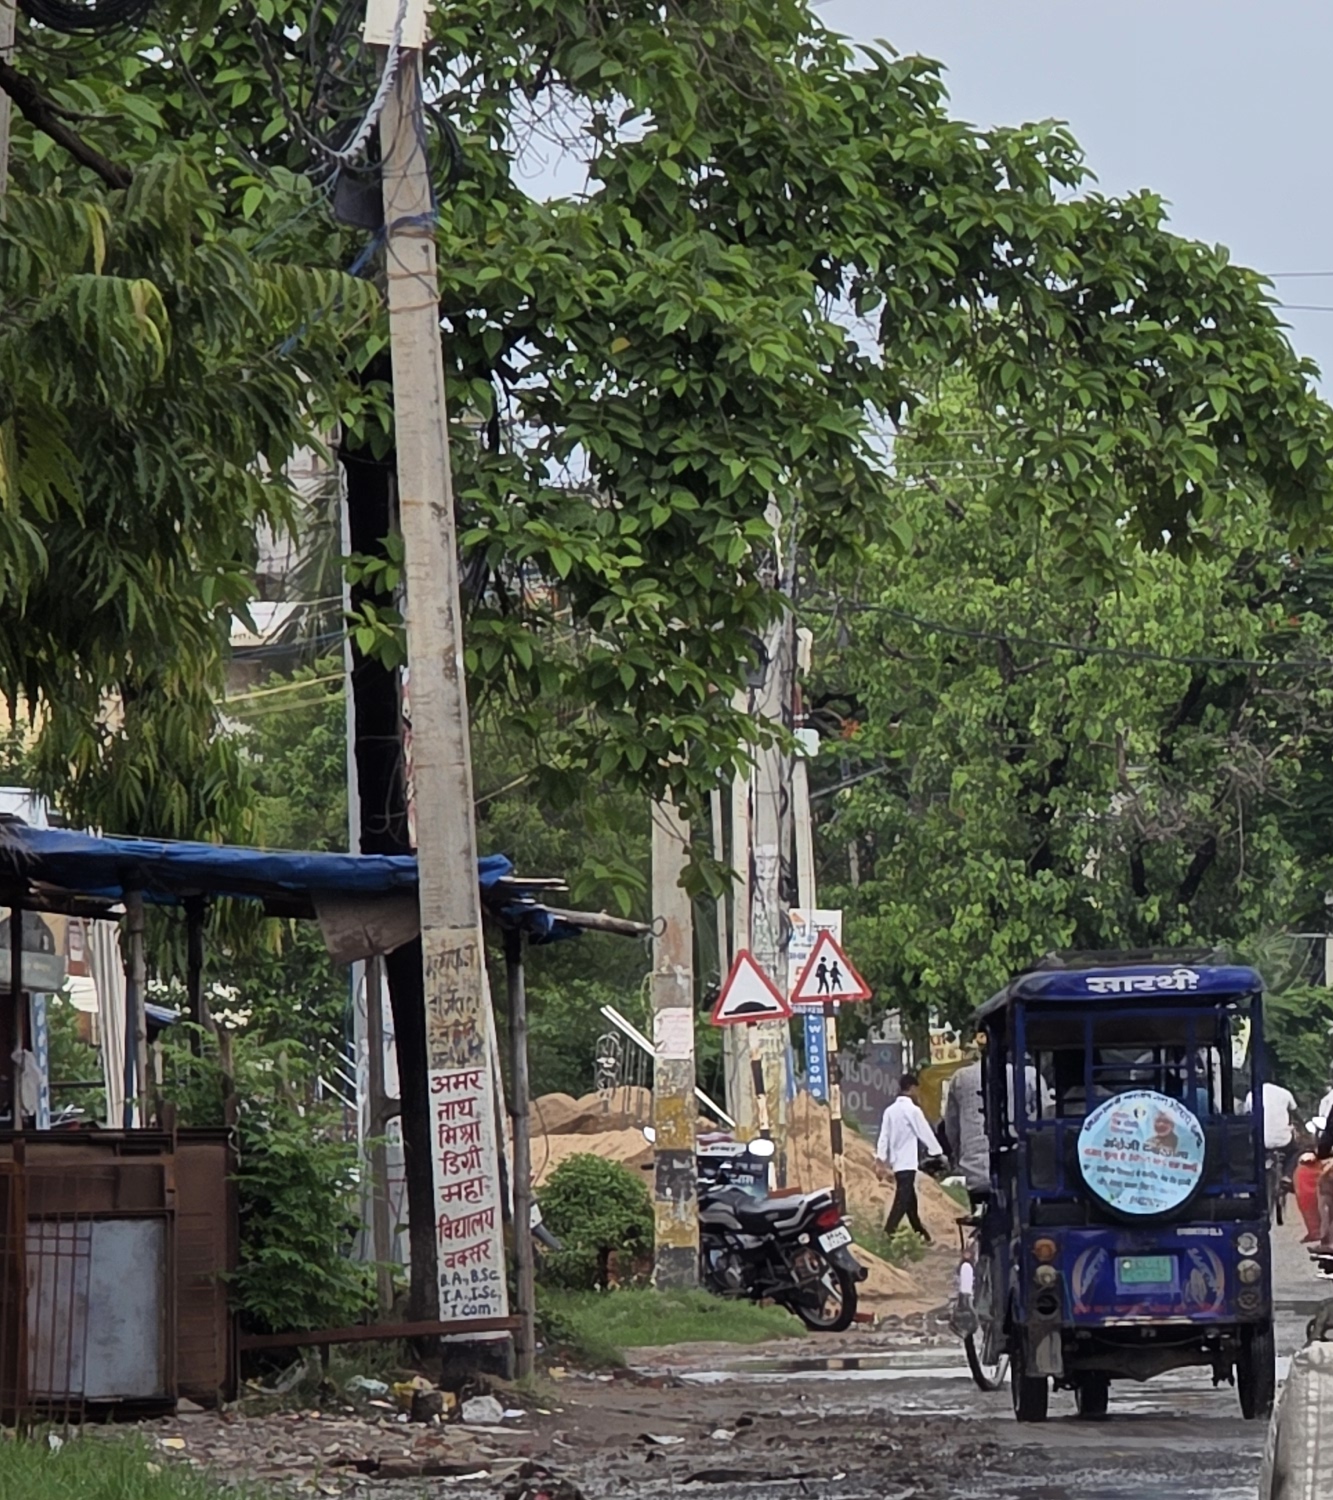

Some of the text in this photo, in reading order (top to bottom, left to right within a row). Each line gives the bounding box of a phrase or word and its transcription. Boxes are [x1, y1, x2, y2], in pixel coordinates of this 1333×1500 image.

[808, 1025, 822, 1083] WISDOM
[431, 1070, 485, 1094] अमर
[437, 1097, 478, 1121] नाथ
[438, 1121, 481, 1149] मिश्रा
[438, 1145, 484, 1176] डिग्री
[438, 1175, 488, 1204] महा
[436, 1206, 496, 1248] विद्यालय
